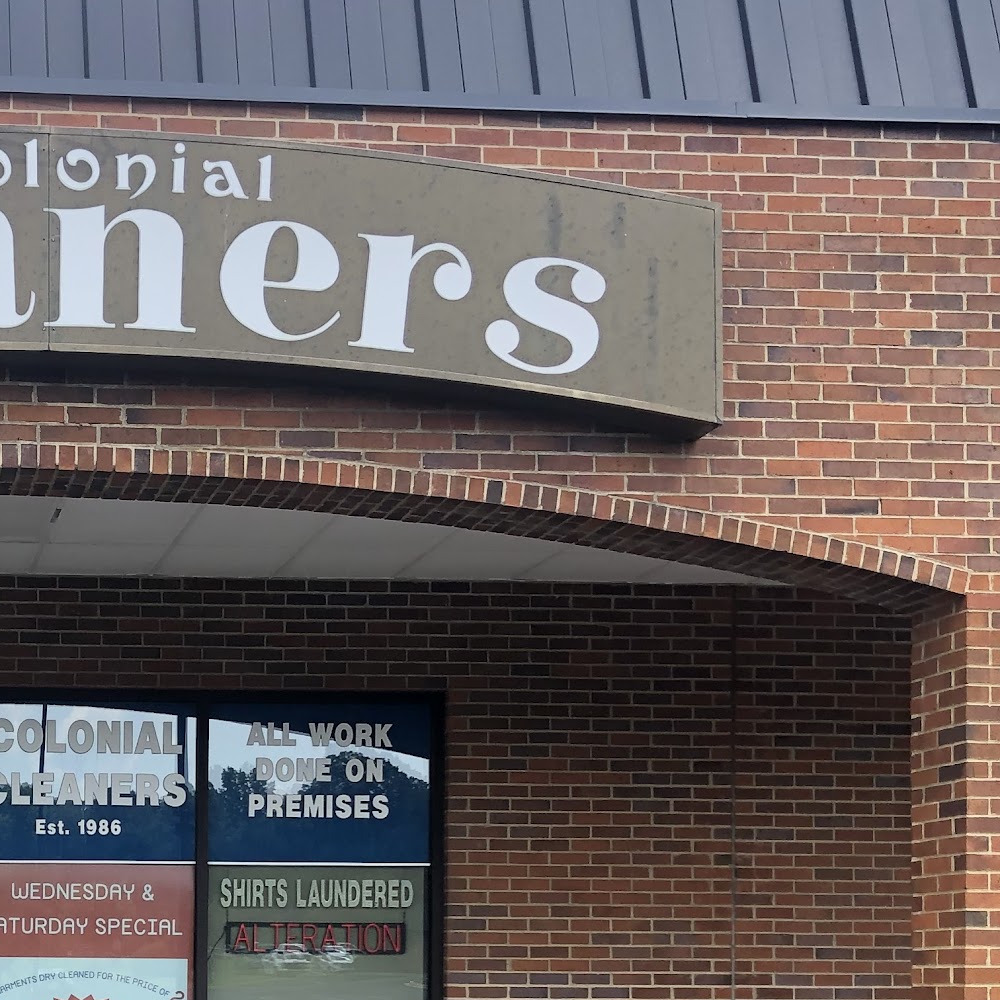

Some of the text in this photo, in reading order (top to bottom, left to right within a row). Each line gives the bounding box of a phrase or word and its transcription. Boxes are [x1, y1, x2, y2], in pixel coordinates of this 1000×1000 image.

[246, 722, 393, 748] ALL WORK
[255, 757, 384, 783] DONE ON
[248, 794, 390, 820] PREMISES
[35, 818, 122, 836] Est. 1986
[11, 882, 155, 901] WEDNESDAY &
[220, 878, 414, 908] SHIRTS LAUNDERED
[95, 918, 183, 936] SPECIAL
[232, 922, 402, 953] ALTERATION
[38, 972, 56, 982] DRY
[57, 970, 95, 979] CLEANED
[96, 971, 113, 980] FOR
[115, 974, 131, 984] THE
[131, 977, 159, 993] PRICE
[158, 988, 170, 997] OF
